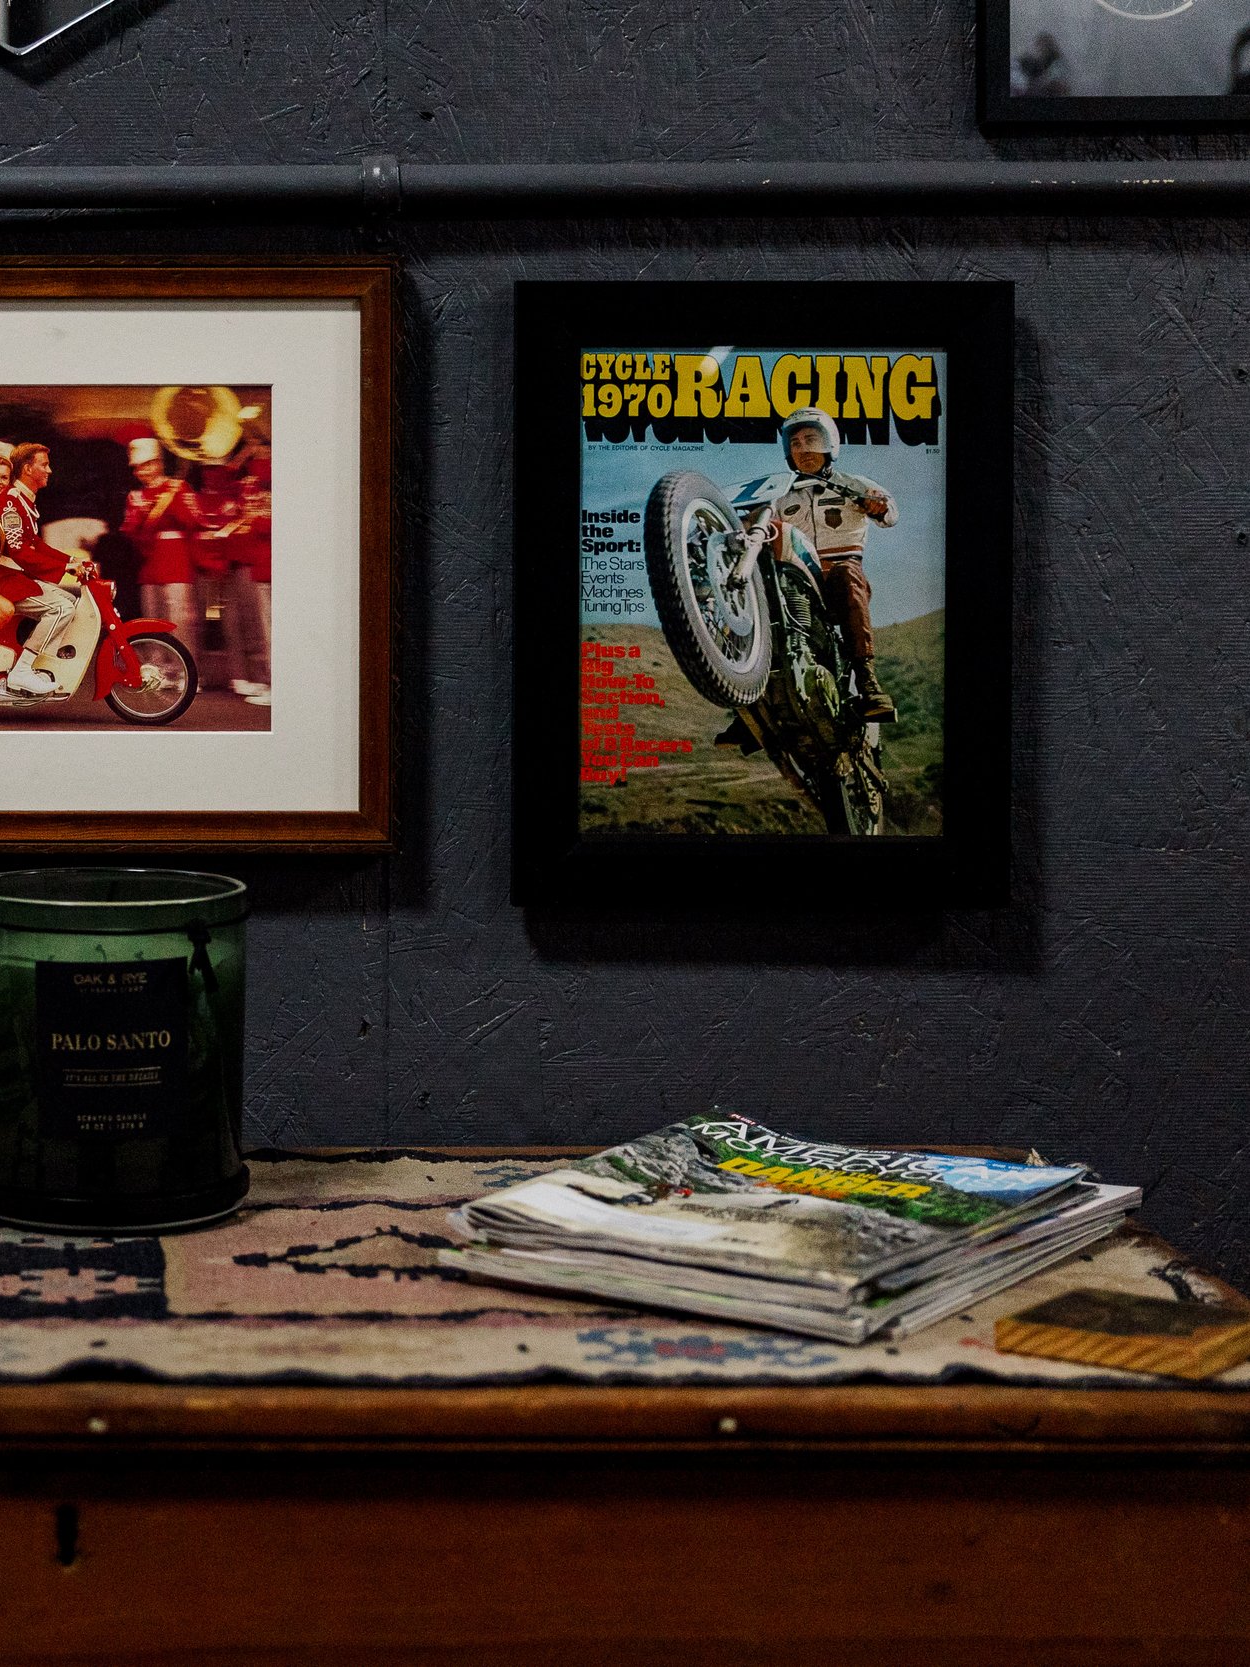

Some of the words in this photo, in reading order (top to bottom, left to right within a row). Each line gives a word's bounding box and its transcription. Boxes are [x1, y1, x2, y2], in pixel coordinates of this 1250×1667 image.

[581, 353, 671, 380] CYCLE
[673, 354, 938, 421] RACING
[581, 383, 672, 418] 1970
[582, 510, 641, 524] Inside
[582, 524, 614, 538] the
[581, 539, 641, 555] Sport:
[582, 557, 607, 571] The
[609, 557, 645, 571] Stars
[581, 599, 622, 615] Tuning
[581, 641, 625, 658] Plus
[628, 645, 641, 658] a
[581, 658, 614, 677] Big
[581, 673, 655, 689] How-To
[581, 688, 666, 709] Section,
[581, 704, 619, 720] and
[582, 721, 636, 736] Tests
[581, 736, 600, 751] of
[604, 736, 617, 751] 8
[620, 736, 693, 753] Racers
[581, 751, 617, 767] You
[620, 751, 659, 767] Can
[580, 767, 627, 788] Buy!
[51, 1033, 101, 1050] PALO
[106, 1030, 171, 1050] SANTO
[690, 1121, 1072, 1183] AMERICAN
[717, 1157, 932, 1199] DANGER
